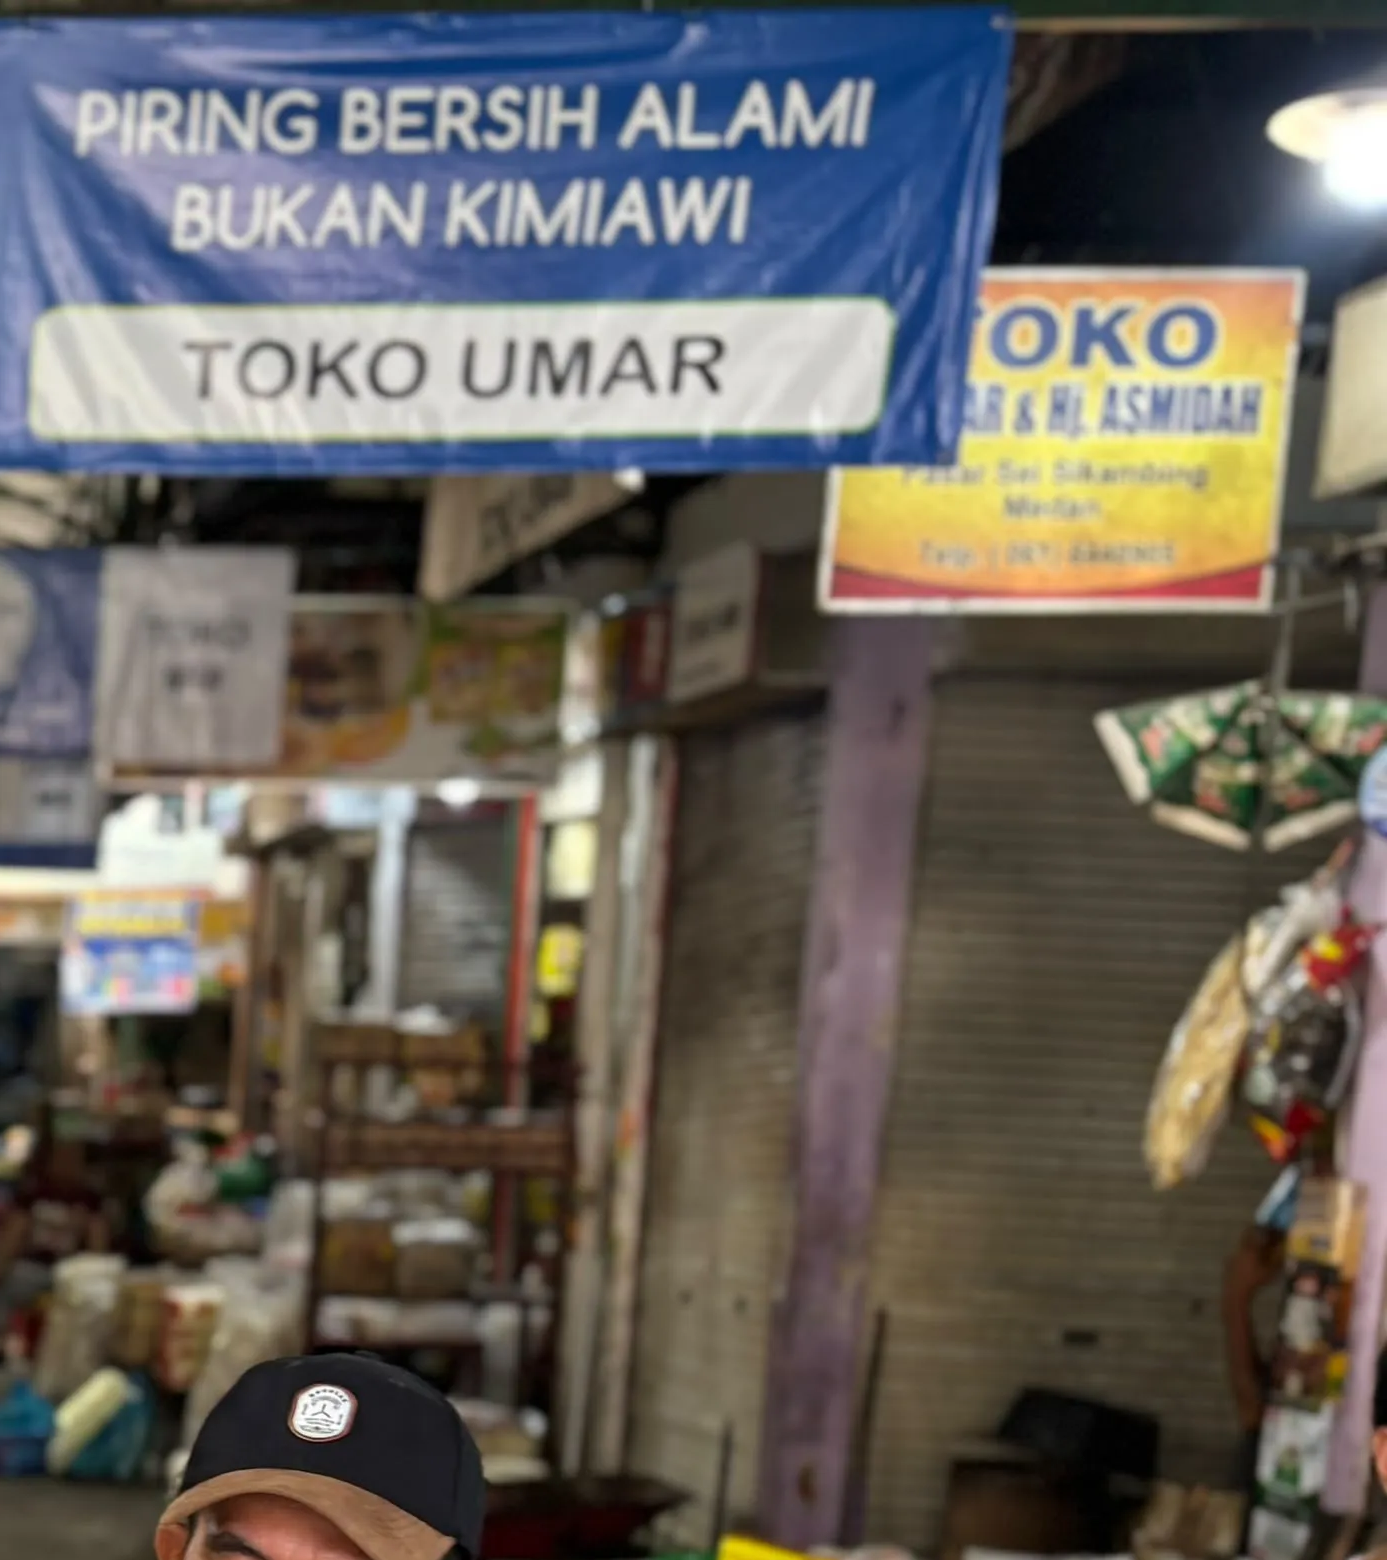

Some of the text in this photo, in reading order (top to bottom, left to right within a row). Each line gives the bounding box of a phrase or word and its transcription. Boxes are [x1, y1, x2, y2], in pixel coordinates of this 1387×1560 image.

[75, 78, 877, 157] PIRING BERSIH ALAMI
[170, 178, 752, 252] BUKAN KIMIAWI
[183, 335, 728, 402] TOKO UMAR
[975, 304, 1218, 370] OKO
